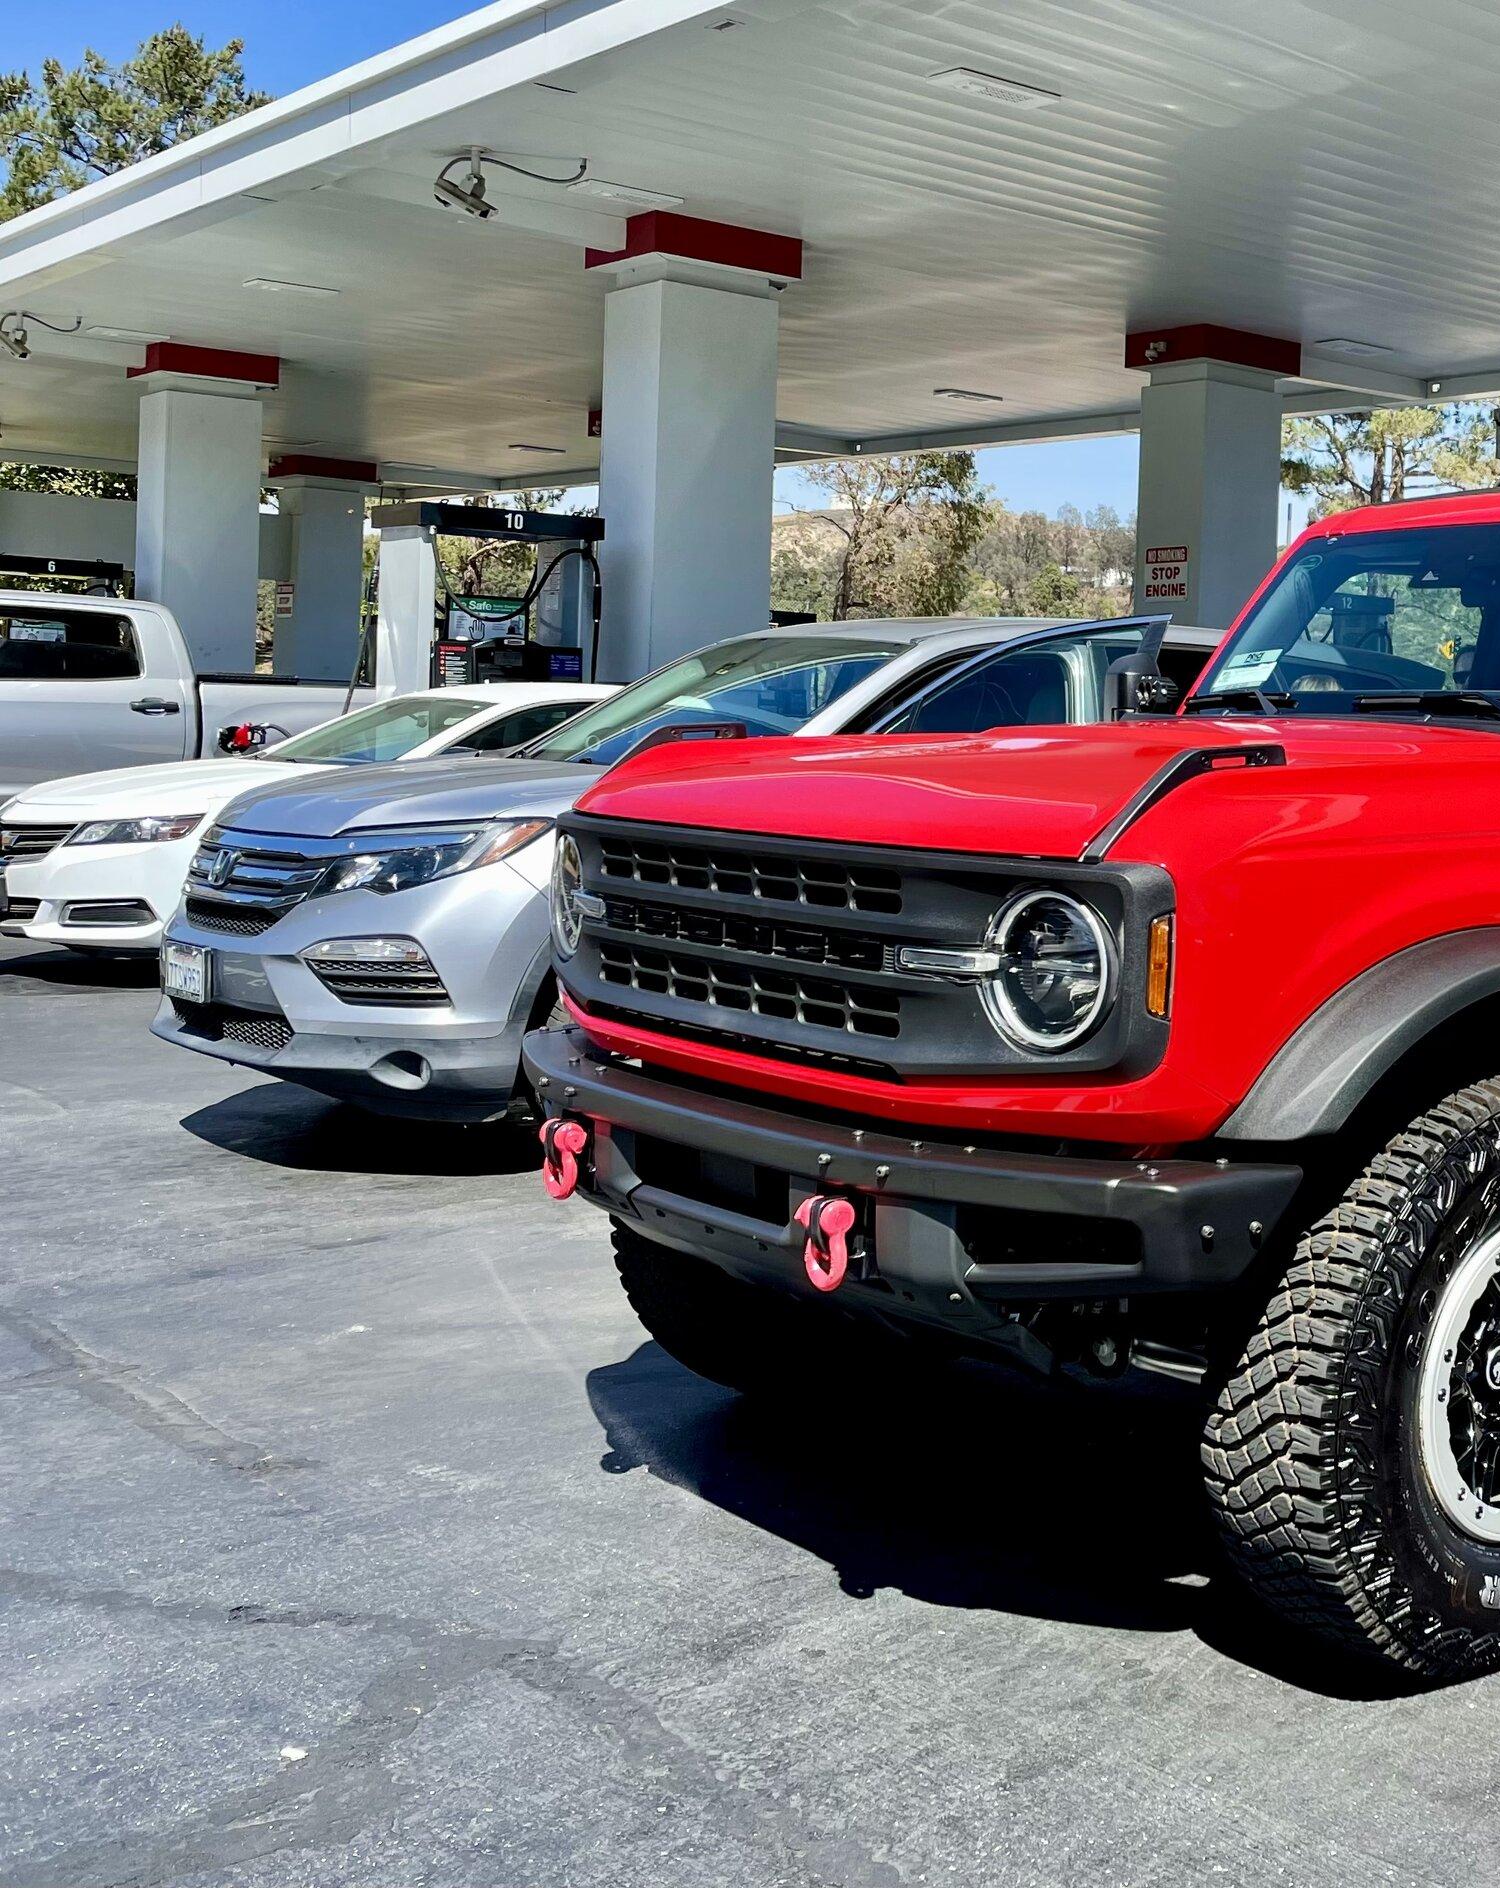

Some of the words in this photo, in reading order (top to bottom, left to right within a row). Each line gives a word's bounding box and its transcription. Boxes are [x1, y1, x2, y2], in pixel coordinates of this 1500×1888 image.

[504, 513, 524, 530] 10
[47, 561, 56, 572] 6
[1152, 567, 1180, 580] STOP
[1146, 583, 1186, 597] ENGINE
[468, 600, 492, 611] Safe
[1342, 597, 1353, 609] 12
